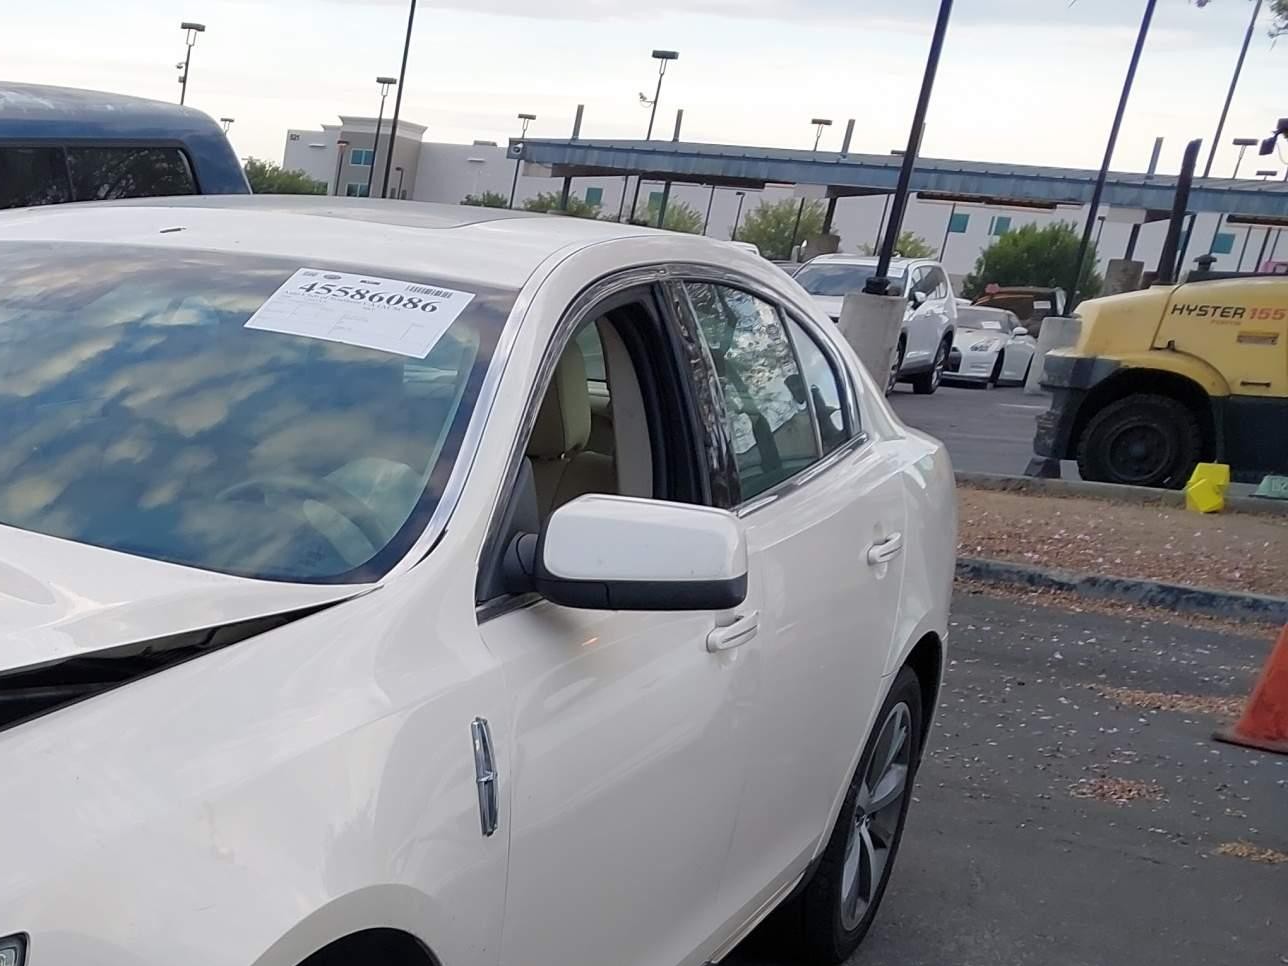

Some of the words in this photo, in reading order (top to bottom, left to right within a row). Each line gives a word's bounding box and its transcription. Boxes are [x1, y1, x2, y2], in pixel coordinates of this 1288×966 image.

[298, 281, 439, 313] 45586086
[1171, 303, 1246, 319] HYSTER
[1249, 307, 1287, 321] 155
